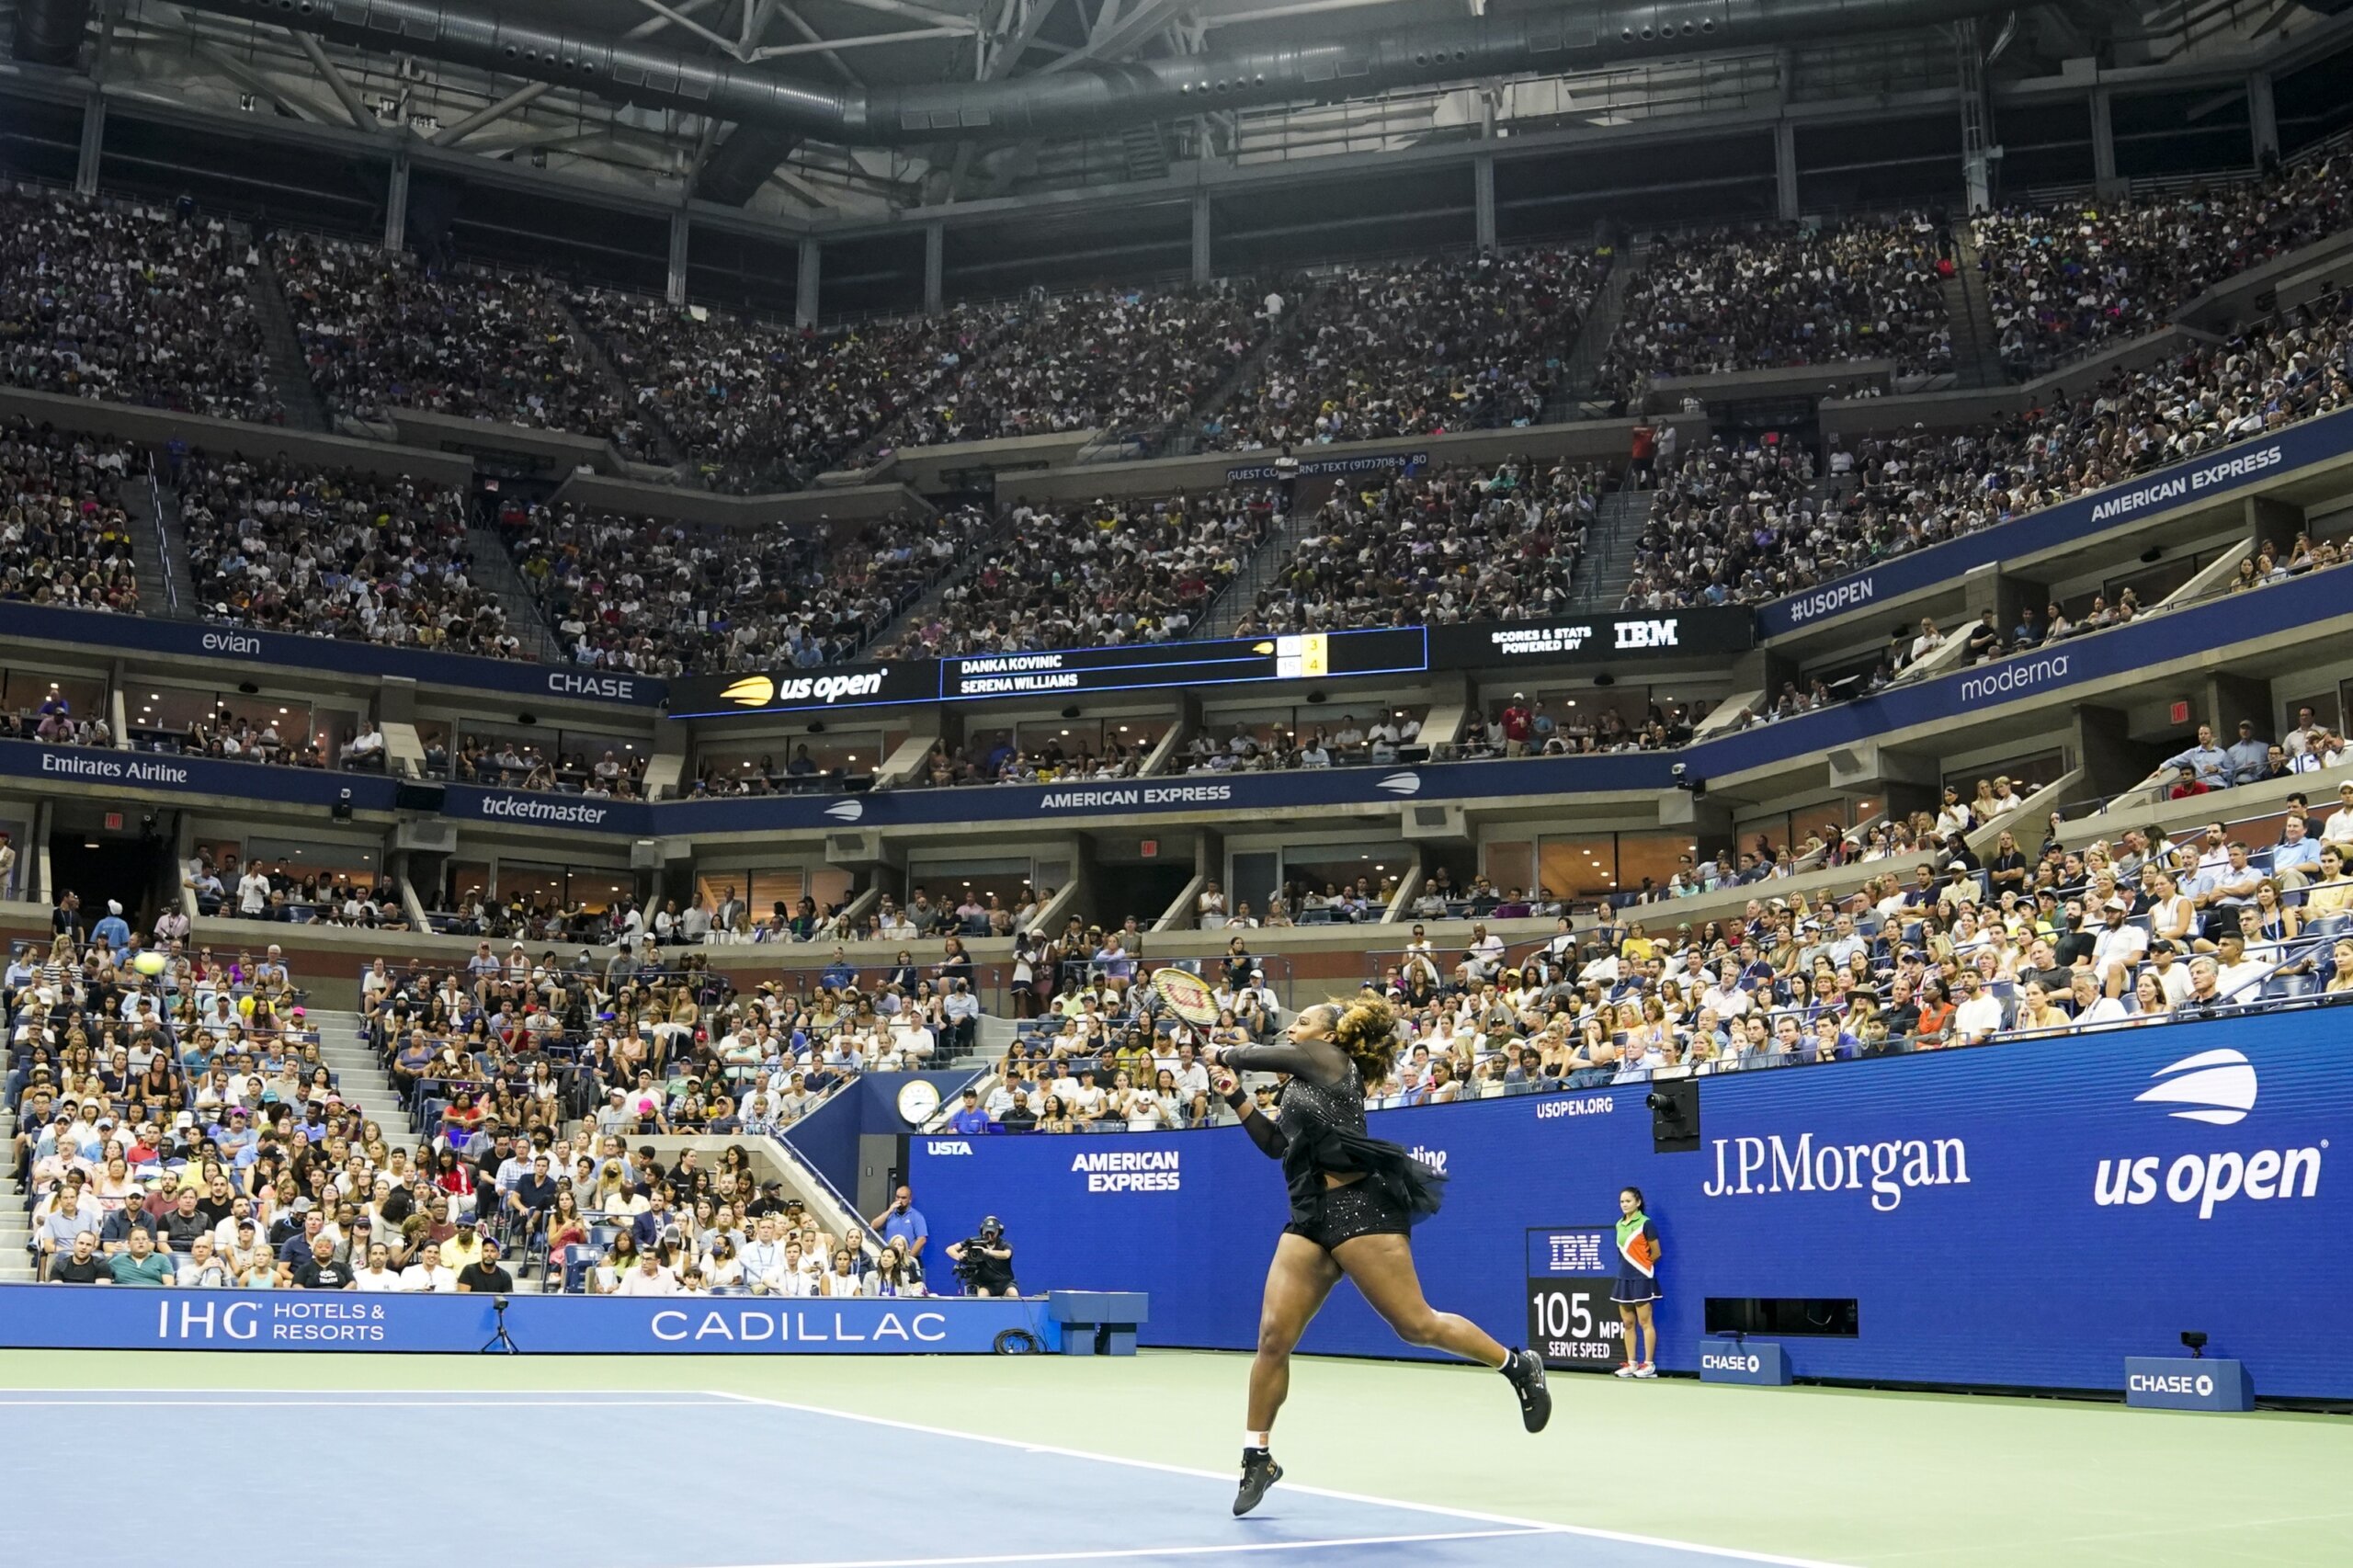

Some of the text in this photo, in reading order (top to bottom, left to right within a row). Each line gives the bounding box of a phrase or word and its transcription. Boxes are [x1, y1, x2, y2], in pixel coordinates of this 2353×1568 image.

[1227, 467, 1260, 481] GUEST
[1322, 460, 1347, 473] TEXT
[2091, 446, 2282, 523] AMERICAN EXPRESS
[1790, 577, 1873, 622] #USOPEN
[202, 631, 260, 654] evian
[1310, 639, 1318, 651] 3
[1492, 630, 1540, 643] SCORES
[1553, 626, 1592, 640] STATS
[1614, 619, 1678, 649] IBM
[1502, 638, 1582, 654] POWERED BY
[961, 654, 1063, 674] DANKA KOVINIC
[1310, 659, 1318, 670] 4
[549, 673, 633, 699] CHASE
[779, 672, 882, 703] us open
[961, 674, 1078, 694] SERENA WILLIAMS
[1961, 655, 2068, 701] moderna
[42, 753, 188, 783] Emirates Airline
[1040, 785, 1232, 809] AMERICAN EXPRESS
[483, 795, 607, 824] ticketmaster
[1537, 1096, 1614, 1119] USOPEN.ORG
[927, 1141, 973, 1155] USTA
[1071, 1151, 1179, 1172] AMERICAN
[1703, 1133, 1971, 1211] J.P.Morgan
[1088, 1172, 1180, 1192] EXPRESS
[2095, 1147, 2321, 1220] us open
[1550, 1234, 1602, 1270] IBM
[159, 1301, 257, 1339] IHG
[274, 1303, 385, 1320] HOTELS &
[1533, 1291, 1592, 1338] 105
[273, 1324, 385, 1341] RESORTS
[651, 1311, 947, 1342] CADILLAC
[1549, 1341, 1610, 1358] SERVE SPEED
[1702, 1355, 1746, 1370] CHASE
[2130, 1375, 2193, 1393] CHASE
